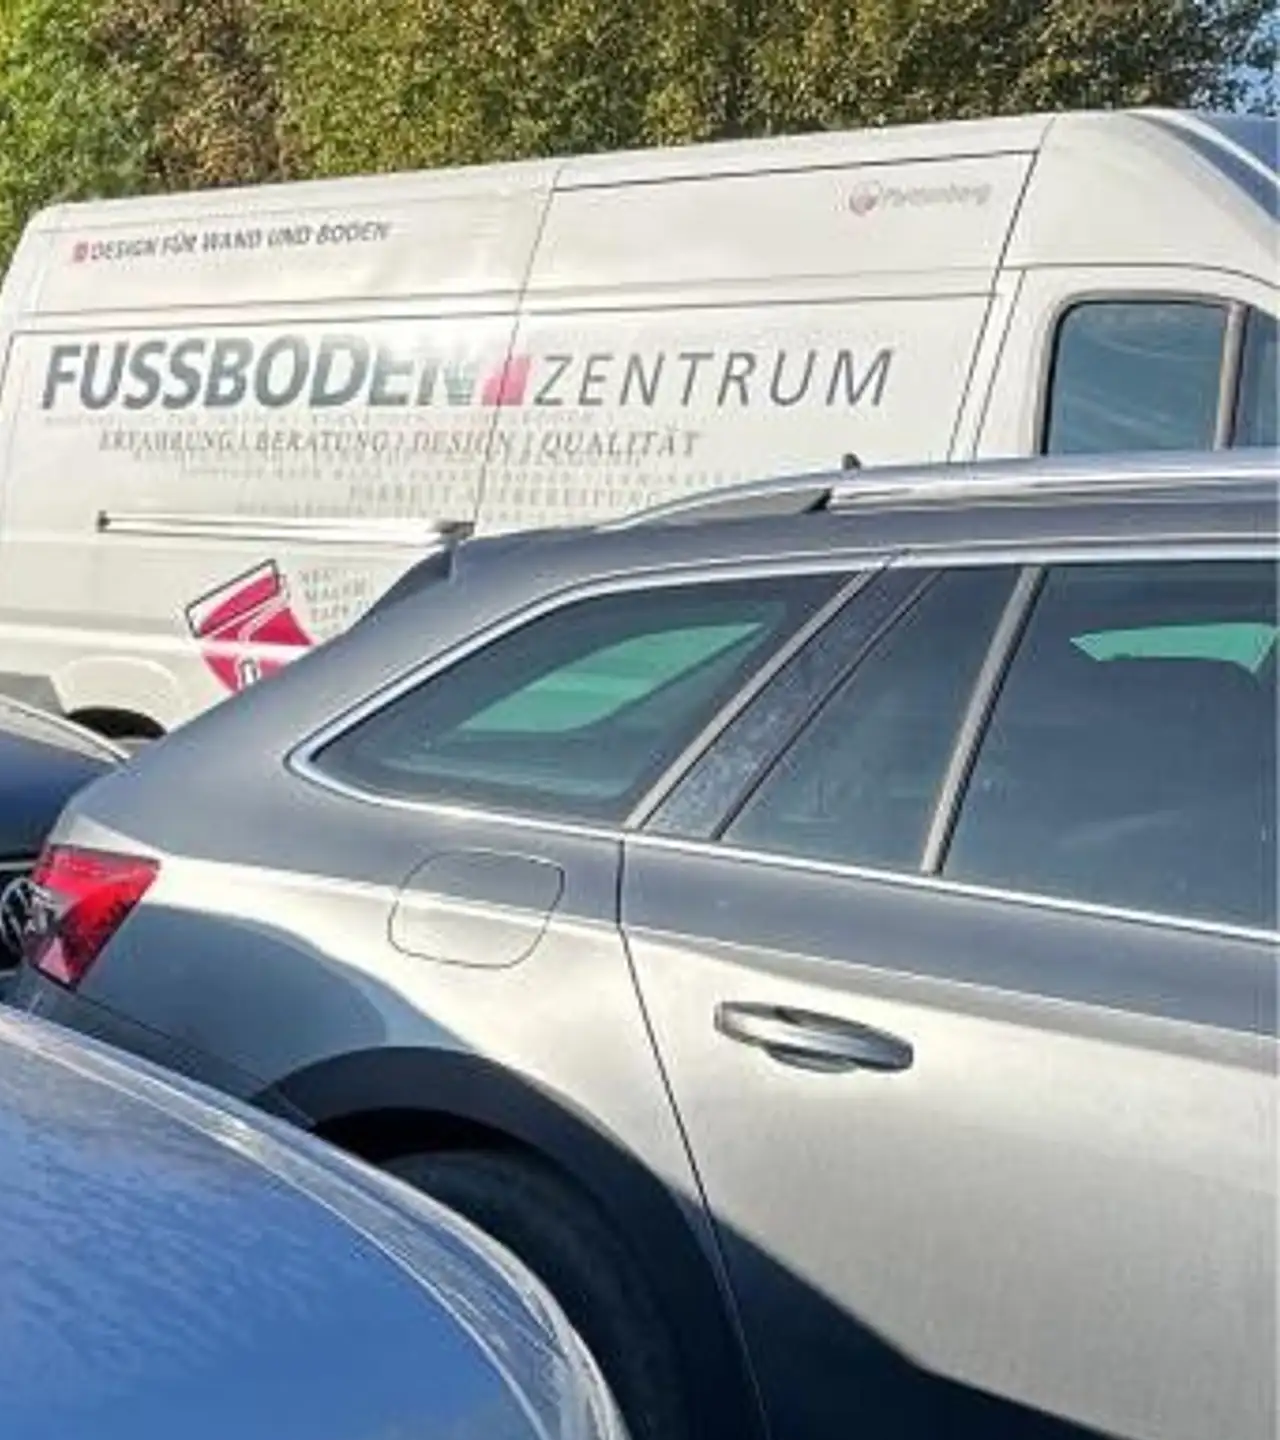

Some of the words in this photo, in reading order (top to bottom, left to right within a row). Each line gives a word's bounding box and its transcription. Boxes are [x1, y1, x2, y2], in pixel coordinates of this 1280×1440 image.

[202, 228, 262, 252] WAND
[267, 224, 311, 248] UND
[316, 220, 390, 246] BODEN
[41, 333, 482, 410] FUSSBODEN
[533, 347, 896, 408] ZENTRUM
[97, 427, 235, 454] ERFAHRUNG
[254, 428, 387, 454] BERATUNG
[411, 428, 515, 456] DESIGN
[542, 424, 702, 458] QUALITÄT
